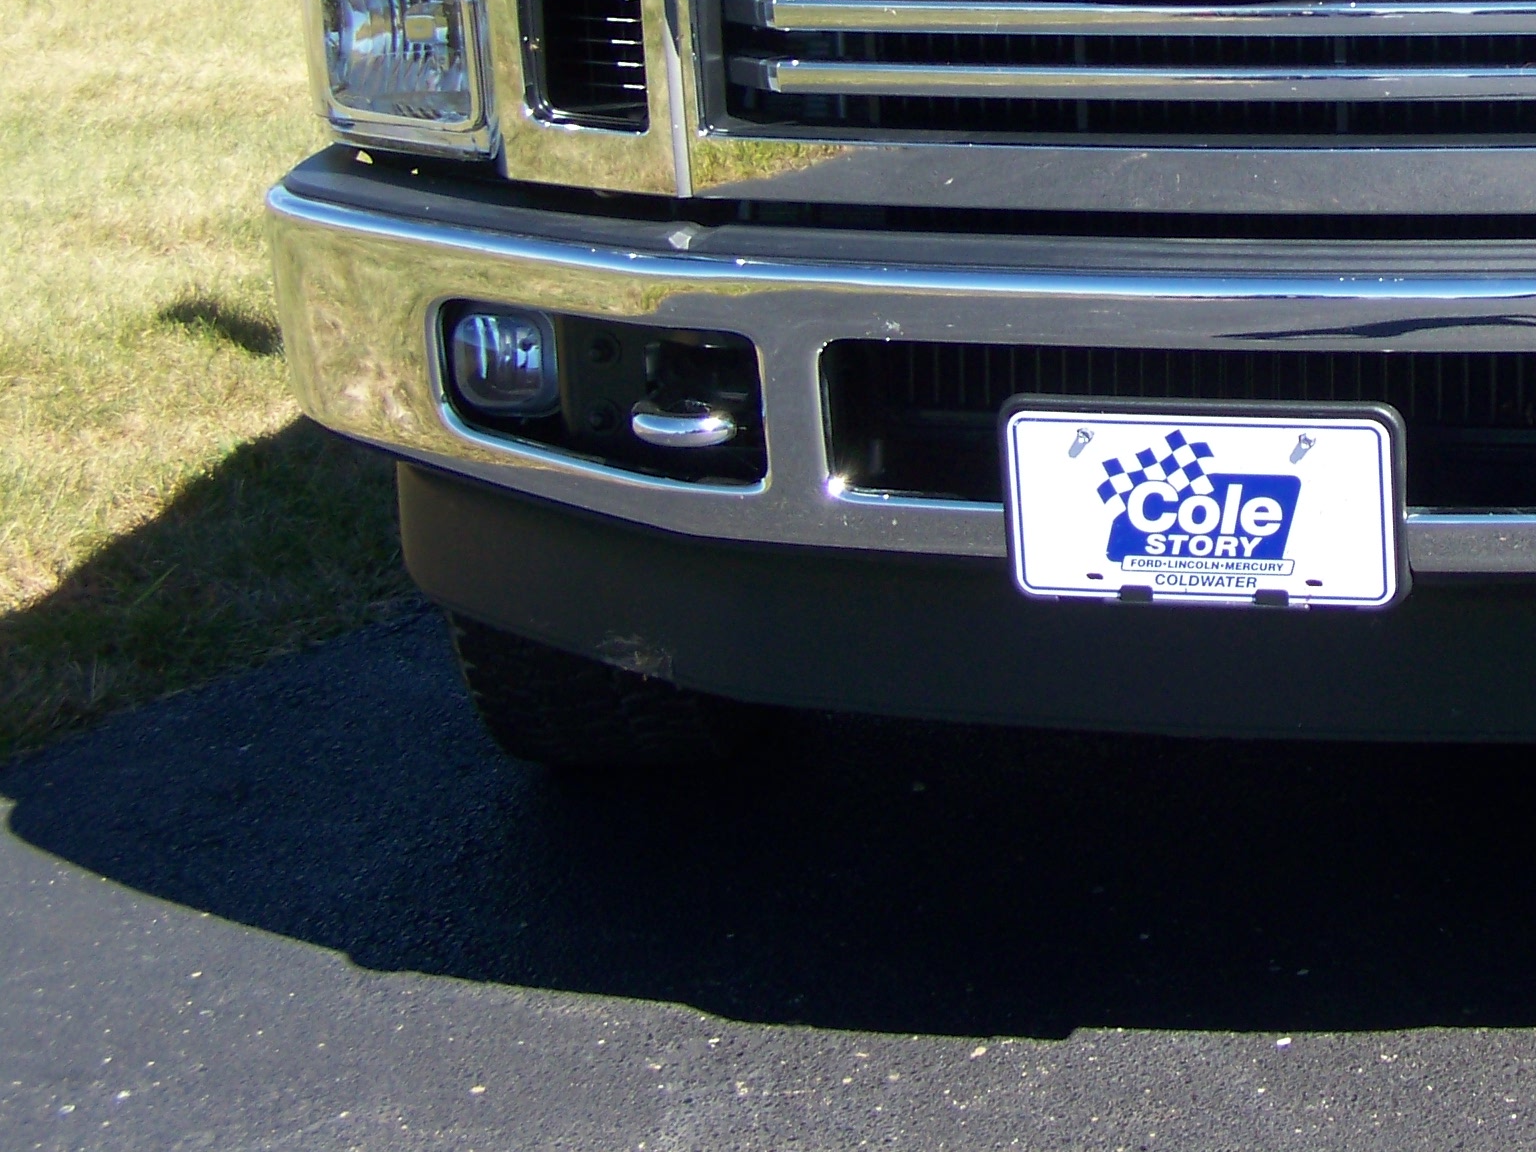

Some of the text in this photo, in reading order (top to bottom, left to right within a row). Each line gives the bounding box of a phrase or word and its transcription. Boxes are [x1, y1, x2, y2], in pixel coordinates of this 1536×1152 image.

[1126, 480, 1283, 536] Cole
[1144, 533, 1263, 557] STORY
[1155, 574, 1258, 588] COLDWATER
